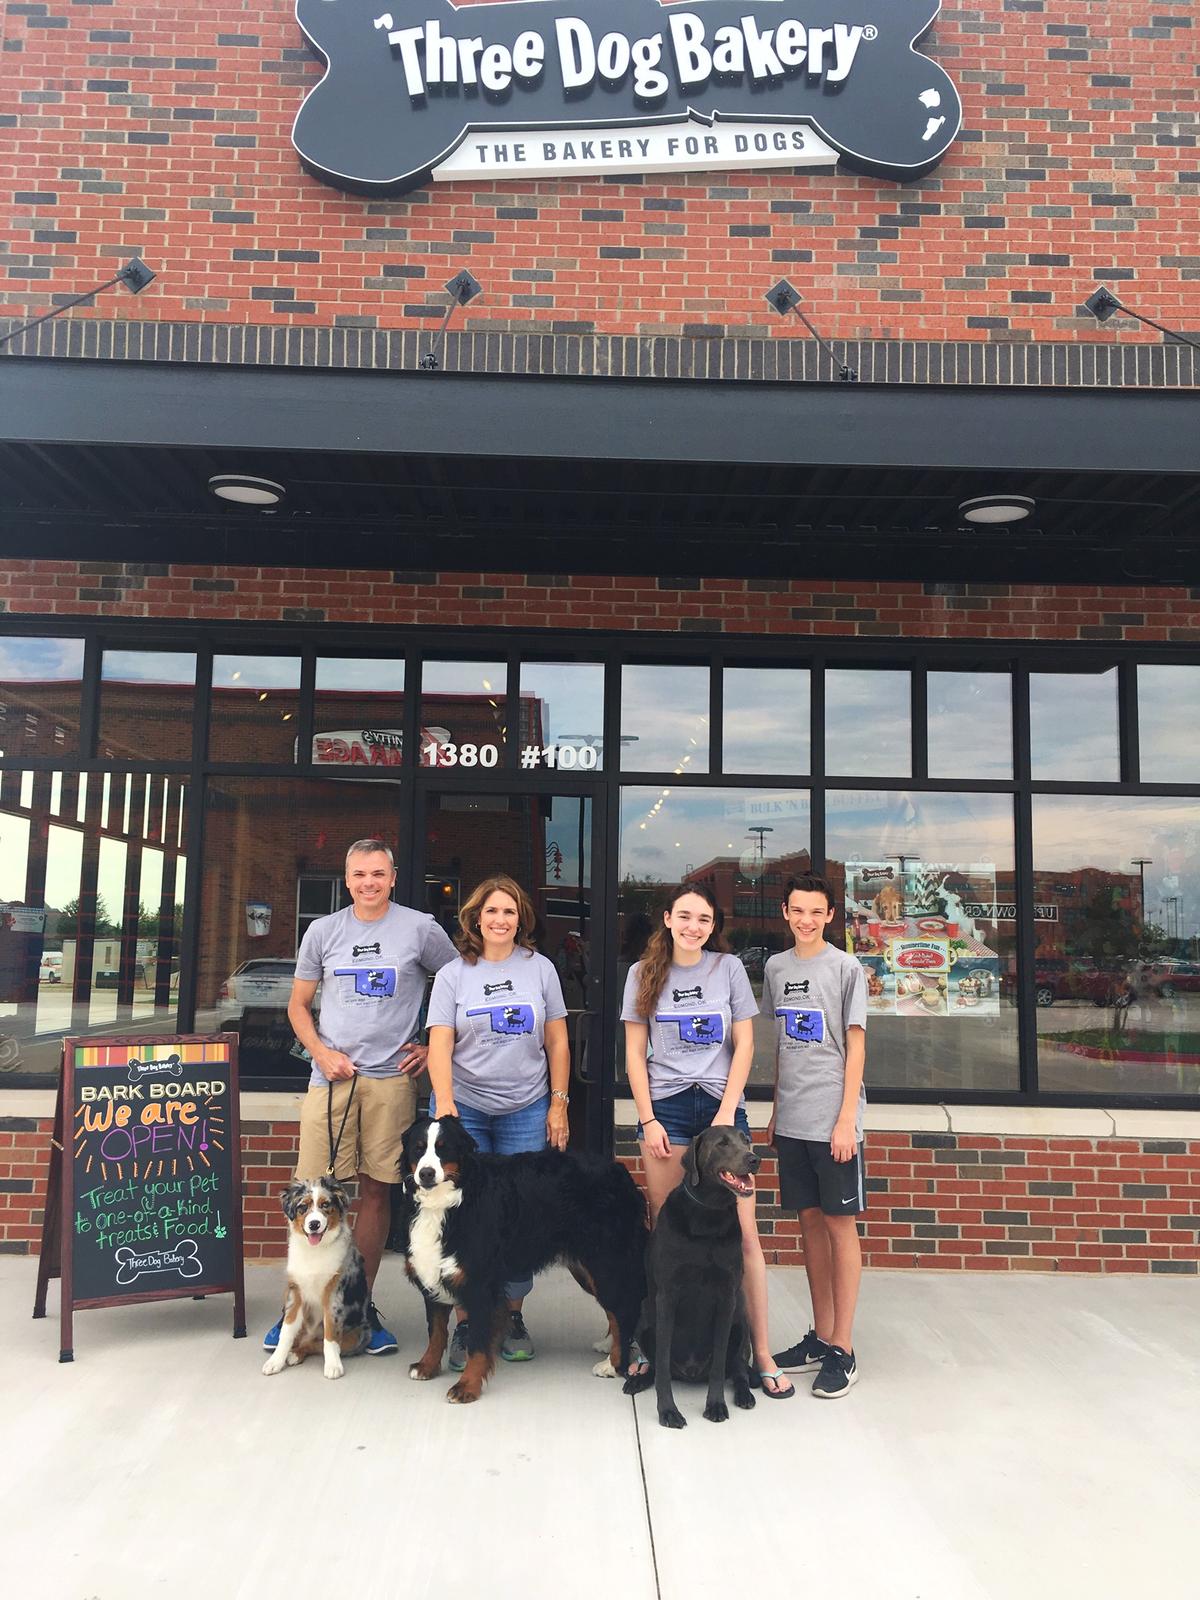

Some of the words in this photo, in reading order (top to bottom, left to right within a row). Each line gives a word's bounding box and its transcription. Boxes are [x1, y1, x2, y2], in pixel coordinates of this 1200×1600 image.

[388, 20, 545, 96] Three
[555, 16, 669, 97] Dog
[475, 143, 527, 164] THE
[543, 138, 650, 161] BAKERY
[667, 135, 718, 156] FOR
[734, 130, 805, 153] DOGS
[423, 742, 498, 768] 1380
[520, 744, 598, 769] #100
[81, 1085, 144, 1102] BARK
[149, 1081, 226, 1099] BOARD
[84, 1100, 132, 1132] We
[141, 1100, 199, 1125] are
[80, 1179, 139, 1209] Treat
[144, 1181, 185, 1210] your
[75, 1211, 92, 1234] to
[127, 1257, 148, 1270] Three
[148, 1255, 161, 1268] Dog
